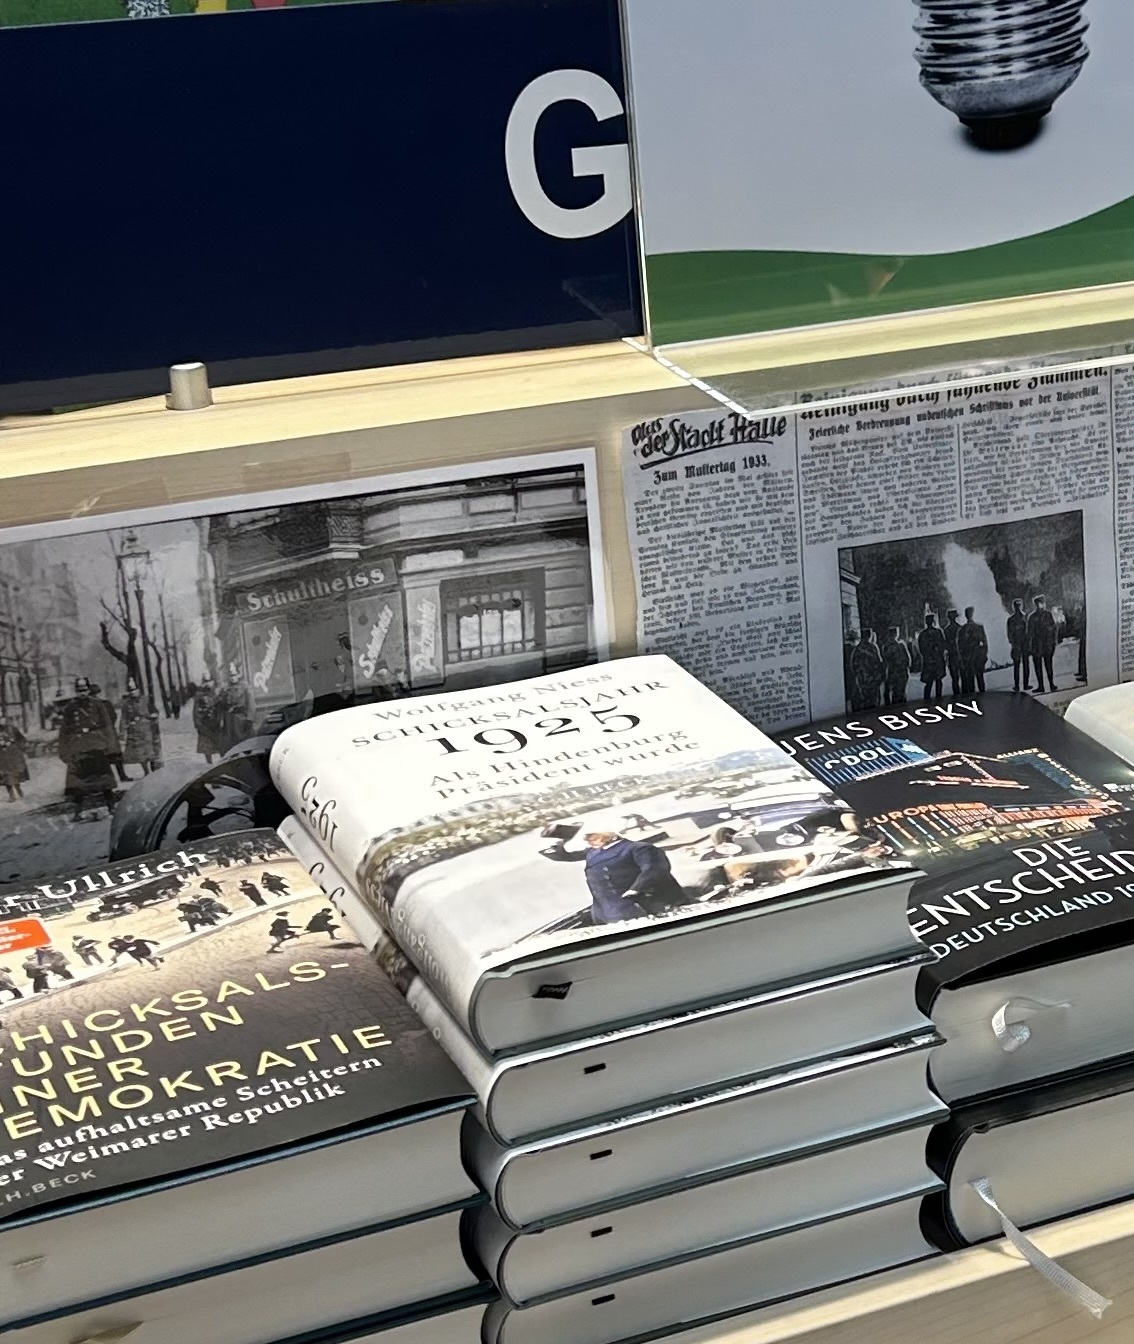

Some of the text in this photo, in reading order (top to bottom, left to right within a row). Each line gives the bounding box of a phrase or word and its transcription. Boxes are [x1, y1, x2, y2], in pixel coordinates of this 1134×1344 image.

[653, 470, 678, 485] Zum
[246, 567, 386, 612] Schultheiss
[351, 679, 670, 748] SCHICKSALSJAHR
[423, 705, 643, 758] 1925
[781, 699, 985, 758] JENS BISKY
[38, 848, 210, 901] Ullrich
[1012, 836, 1091, 869] DIE
[5, 1024, 394, 1142] EMOKRATIE
